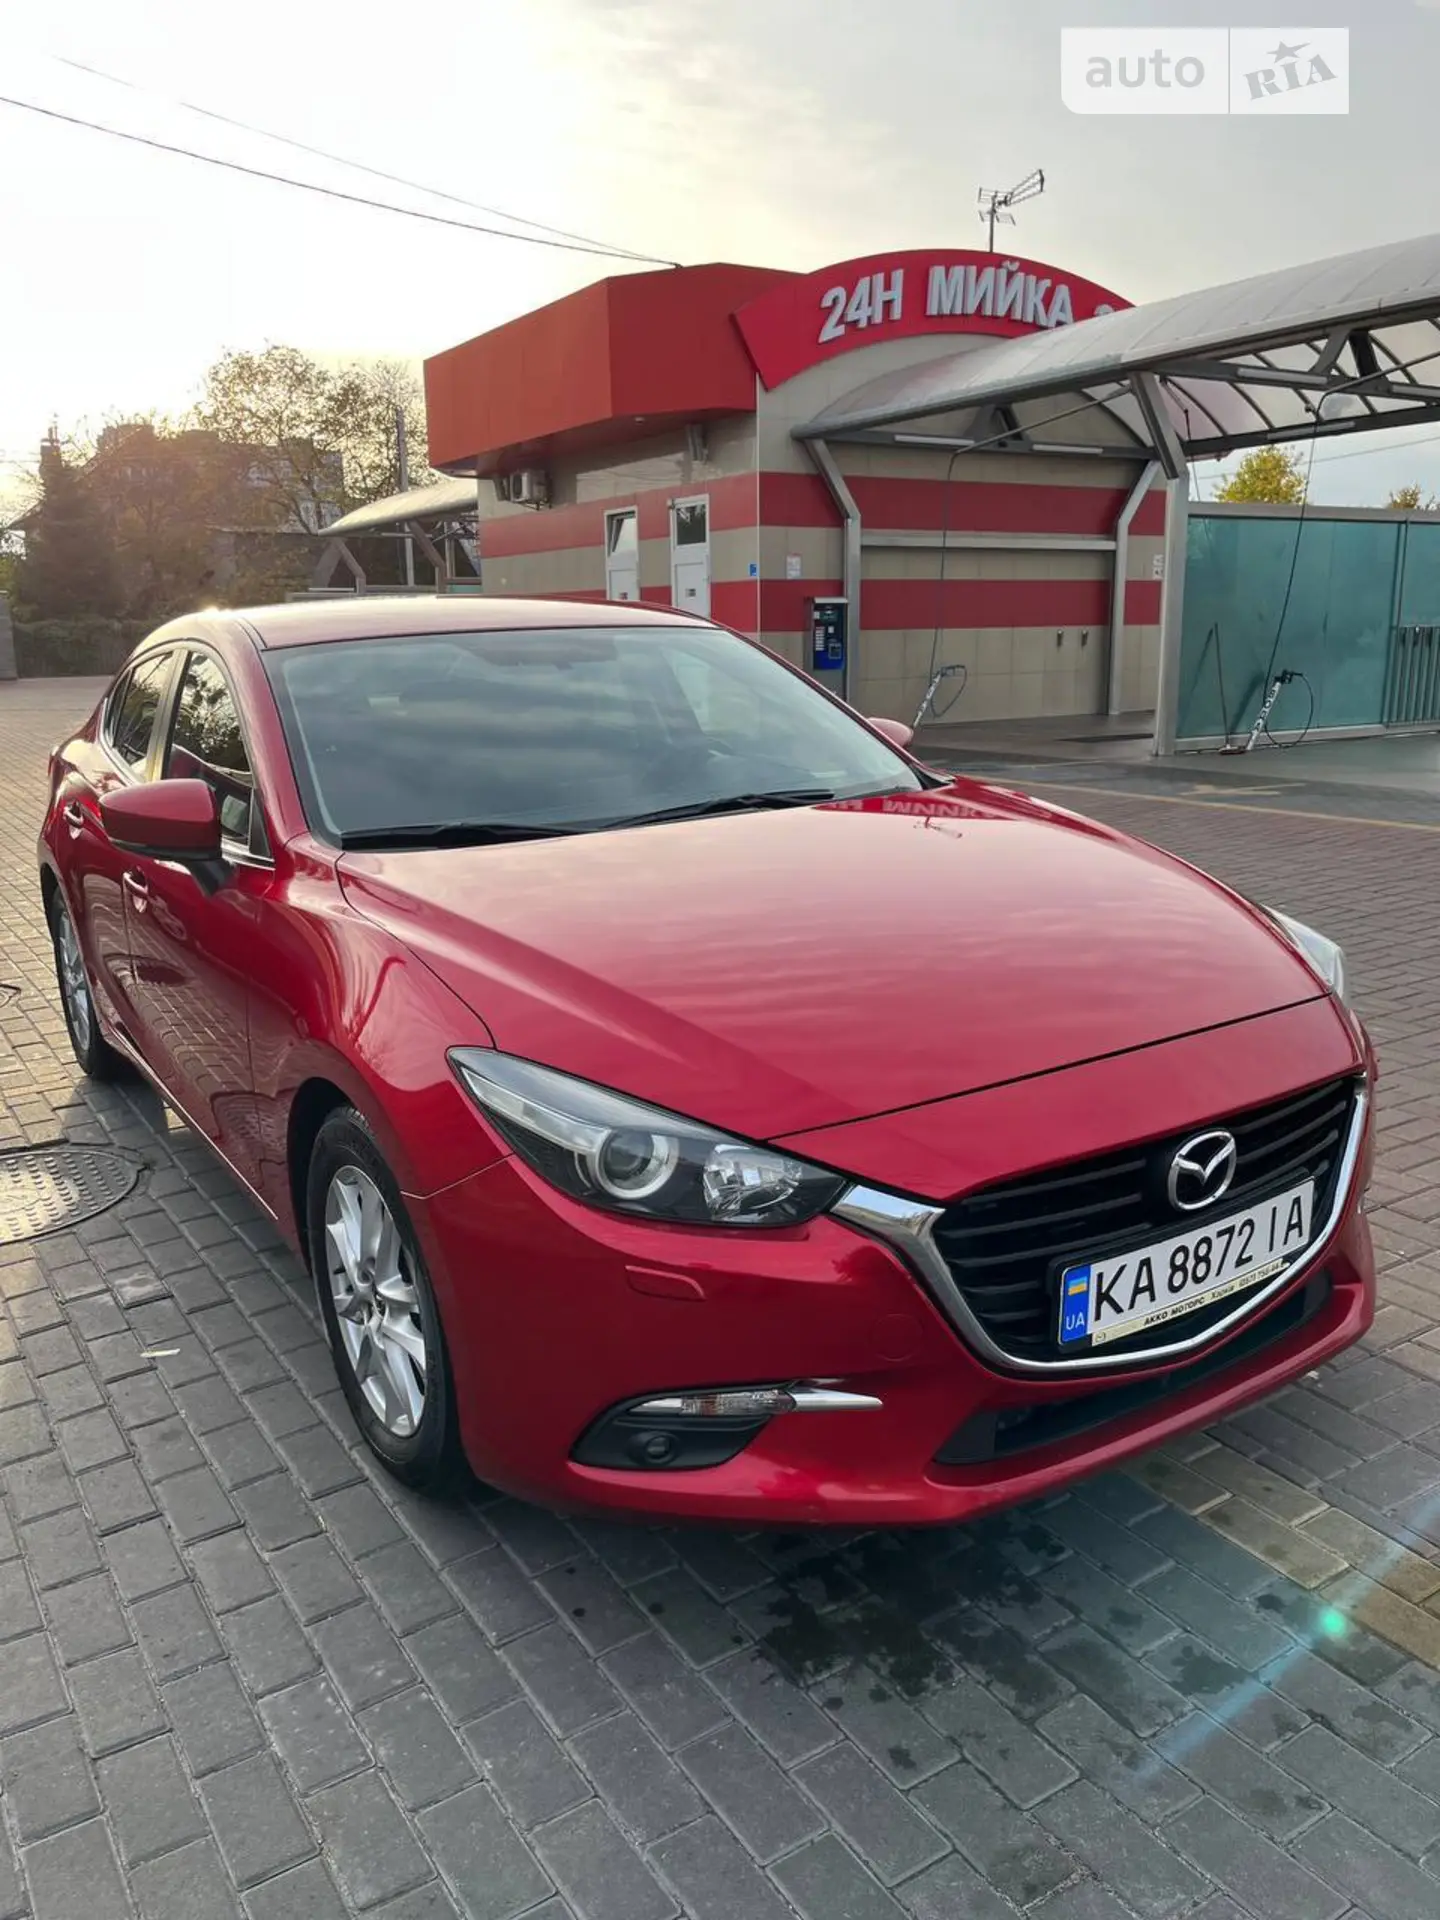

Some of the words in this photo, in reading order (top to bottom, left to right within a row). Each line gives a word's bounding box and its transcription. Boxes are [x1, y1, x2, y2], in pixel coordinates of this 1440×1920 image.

[818, 269, 904, 343] 24H
[925, 260, 1074, 328] МИЙКА
[1094, 1257, 1156, 1322] KA
[1167, 1219, 1256, 1293] 8872
[1268, 1195, 1304, 1253] IA
[1066, 1312, 1086, 1331] UA
